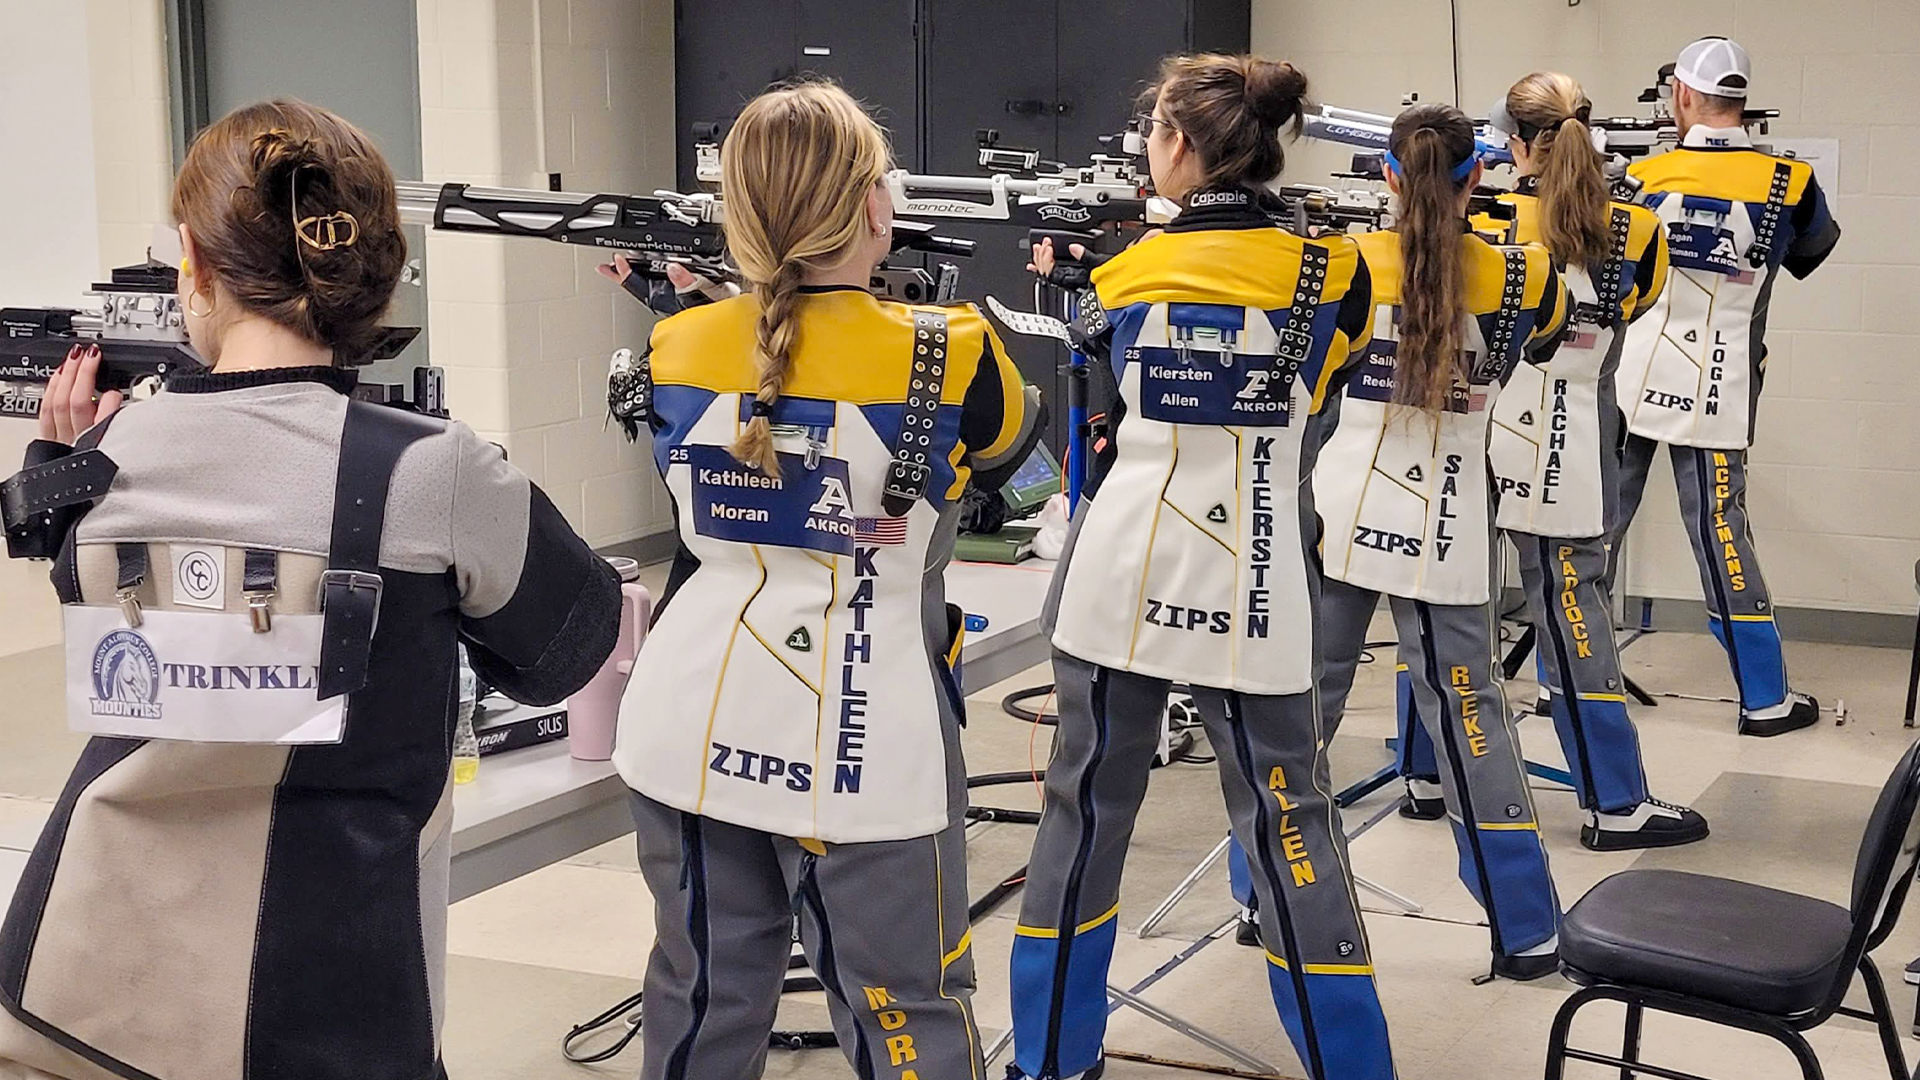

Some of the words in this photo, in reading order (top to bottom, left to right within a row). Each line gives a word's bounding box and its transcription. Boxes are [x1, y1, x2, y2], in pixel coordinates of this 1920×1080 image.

[906, 202, 976, 215] monotec
[1045, 208, 1084, 220] WALTHER
[594, 236, 693, 252] Feinwerkbau
[1125, 349, 1140, 360] 25
[1149, 366, 1213, 382] Kiersten
[1705, 330, 1727, 415] LOGAN
[1160, 393, 1199, 407] Allen
[1231, 401, 1289, 413] AKRON
[1643, 388, 1694, 411] ZIPS
[1542, 379, 1567, 504] RACHAEL
[669, 449, 689, 462] 25
[699, 468, 783, 490] Kathleen
[710, 502, 769, 522] Moran
[1436, 454, 1462, 562] SALLY
[1247, 436, 1276, 638] KIERSTEN
[1354, 525, 1422, 557] ZIPS
[1145, 598, 1231, 634] ZIPS
[163, 662, 319, 690] TRINKL
[833, 547, 880, 793] KATHLEEN
[92, 700, 162, 719] MOUNTIES
[537, 715, 564, 737] SIUS
[709, 741, 813, 793] ZIPS
[1268, 766, 1317, 888] ALLEN
